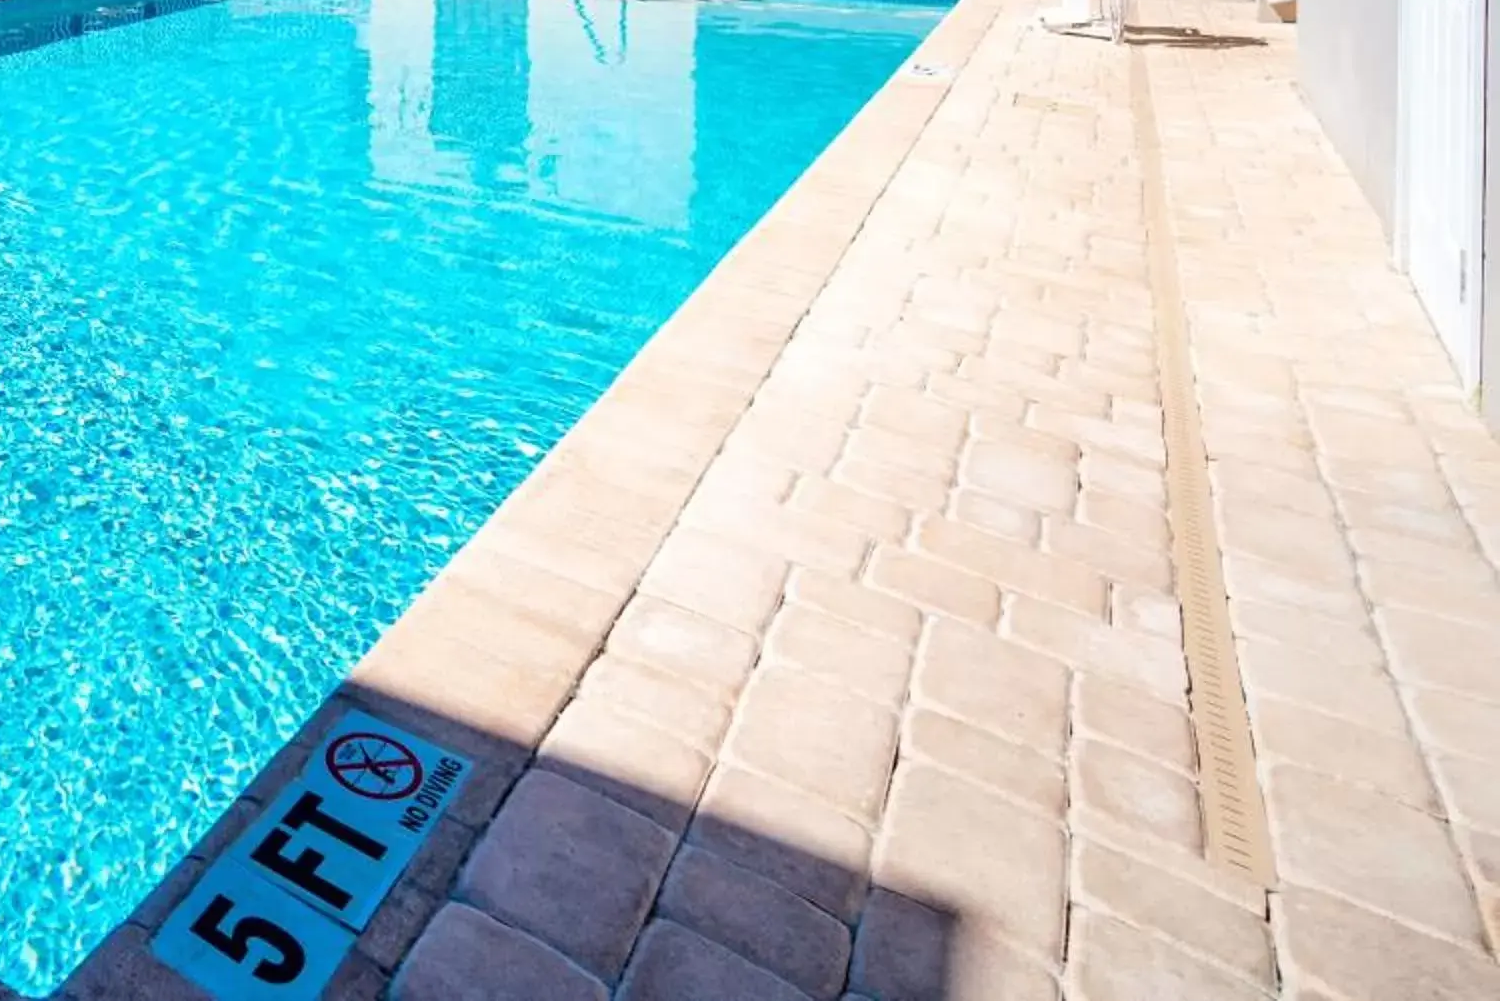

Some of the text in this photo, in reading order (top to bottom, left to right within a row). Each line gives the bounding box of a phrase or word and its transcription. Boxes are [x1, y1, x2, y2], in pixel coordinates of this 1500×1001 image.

[398, 757, 463, 834] NO DIVING
[189, 791, 389, 985] 5 FT
